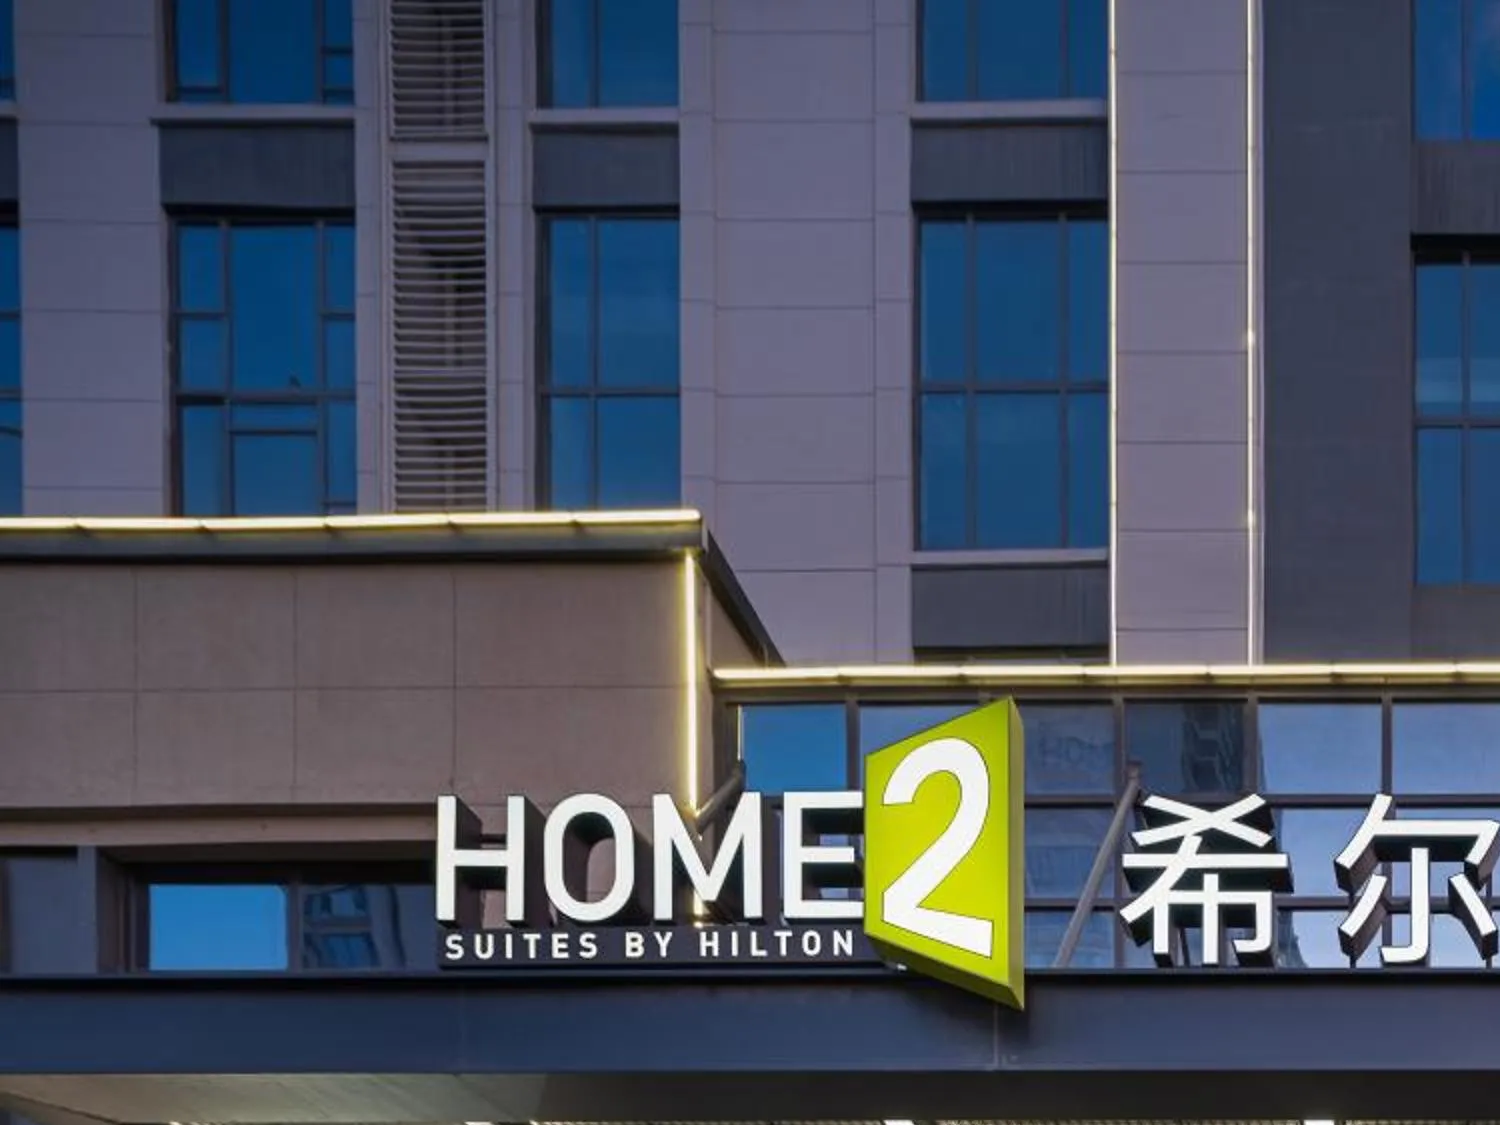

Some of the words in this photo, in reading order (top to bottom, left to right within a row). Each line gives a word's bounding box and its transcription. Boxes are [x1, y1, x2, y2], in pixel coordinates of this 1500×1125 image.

[445, 932, 599, 960] SUITES
[624, 930, 674, 959] BY
[698, 929, 854, 958] HILTON
